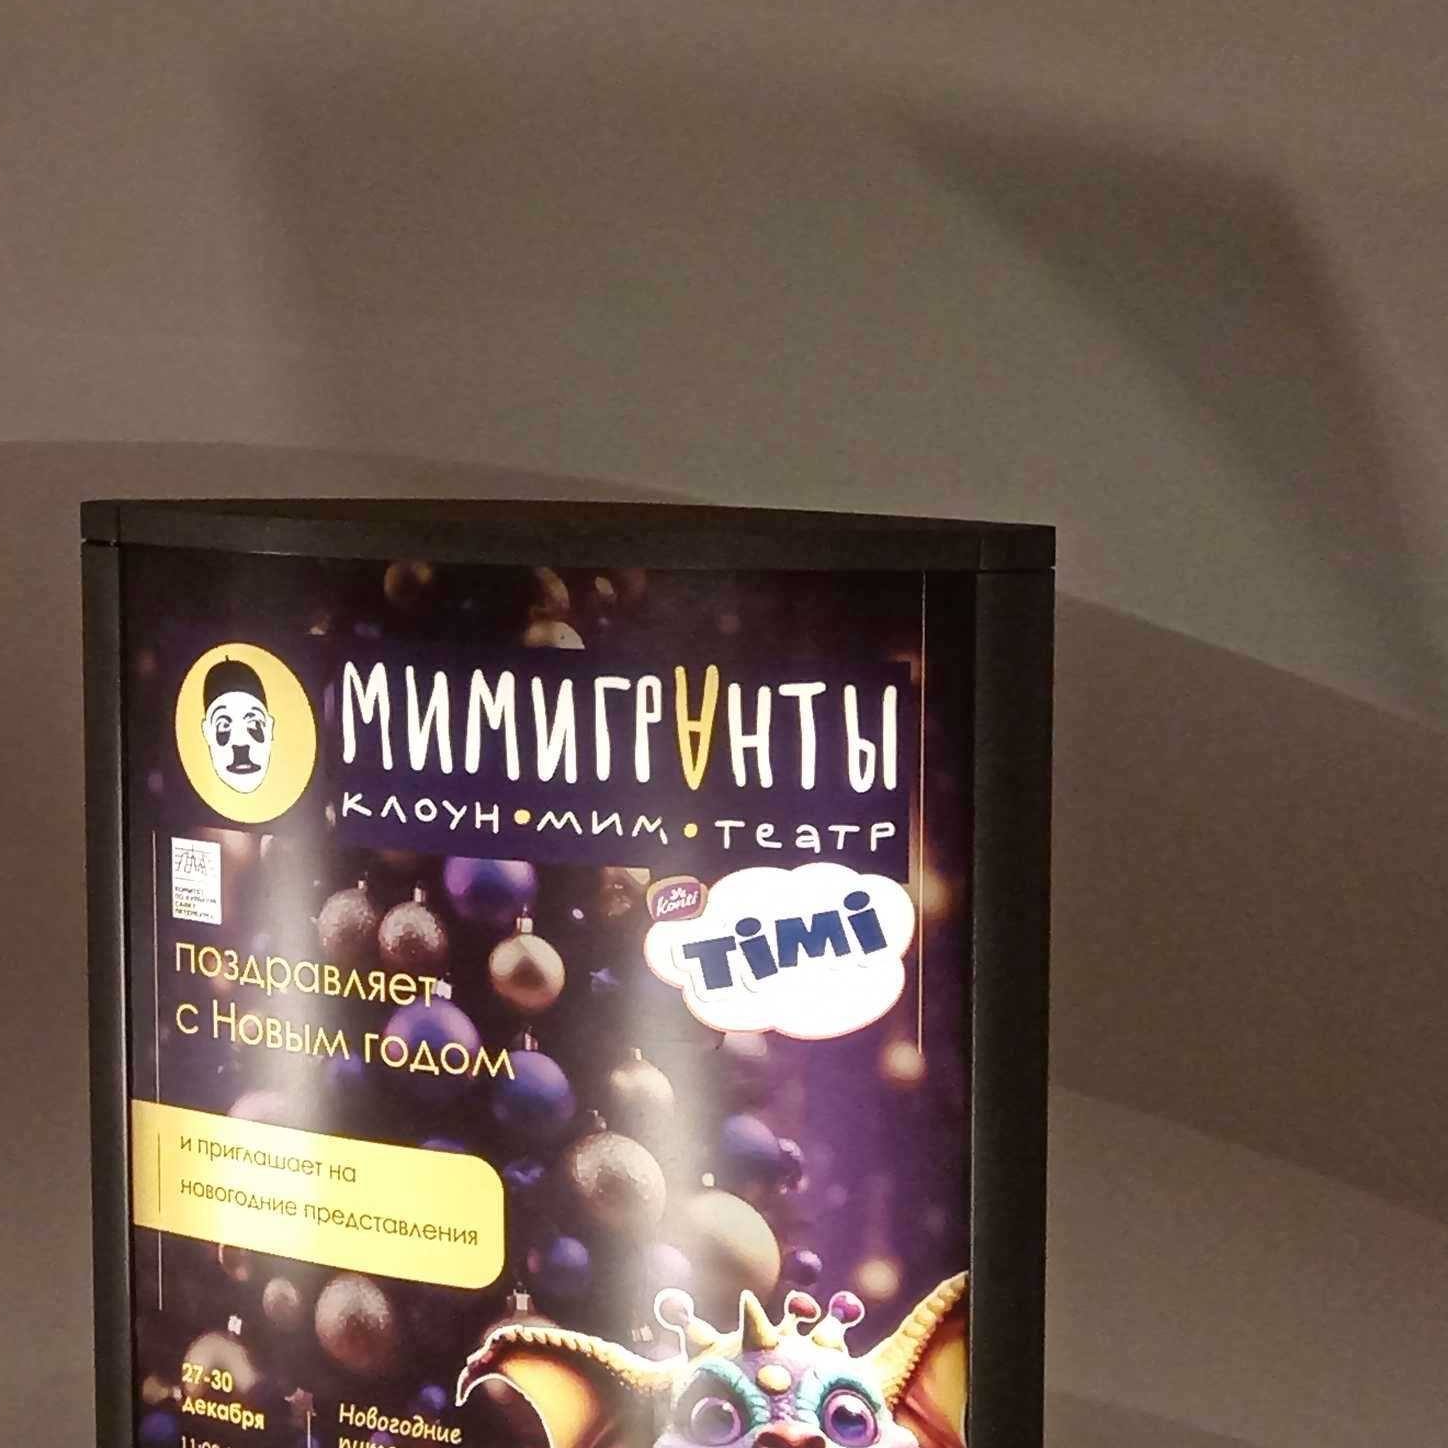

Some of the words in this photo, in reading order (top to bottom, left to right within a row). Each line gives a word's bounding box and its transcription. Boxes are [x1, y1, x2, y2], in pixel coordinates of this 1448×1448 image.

[343, 661, 897, 793] МИМИГРАНТЫ
[175, 942, 436, 1007] поздравляет
[175, 1004, 199, 1034] с
[212, 999, 350, 1060] Новым
[364, 1033, 515, 1080] годом
[180, 1136, 191, 1151] и
[197, 1138, 322, 1177] приглашает
[329, 1164, 356, 1183] на
[180, 1179, 297, 1216] новогодние
[304, 1204, 480, 1245] представления
[182, 1362, 233, 1393] 27-30
[182, 1396, 264, 1430] декабря
[339, 1403, 462, 1444] Новогодние
